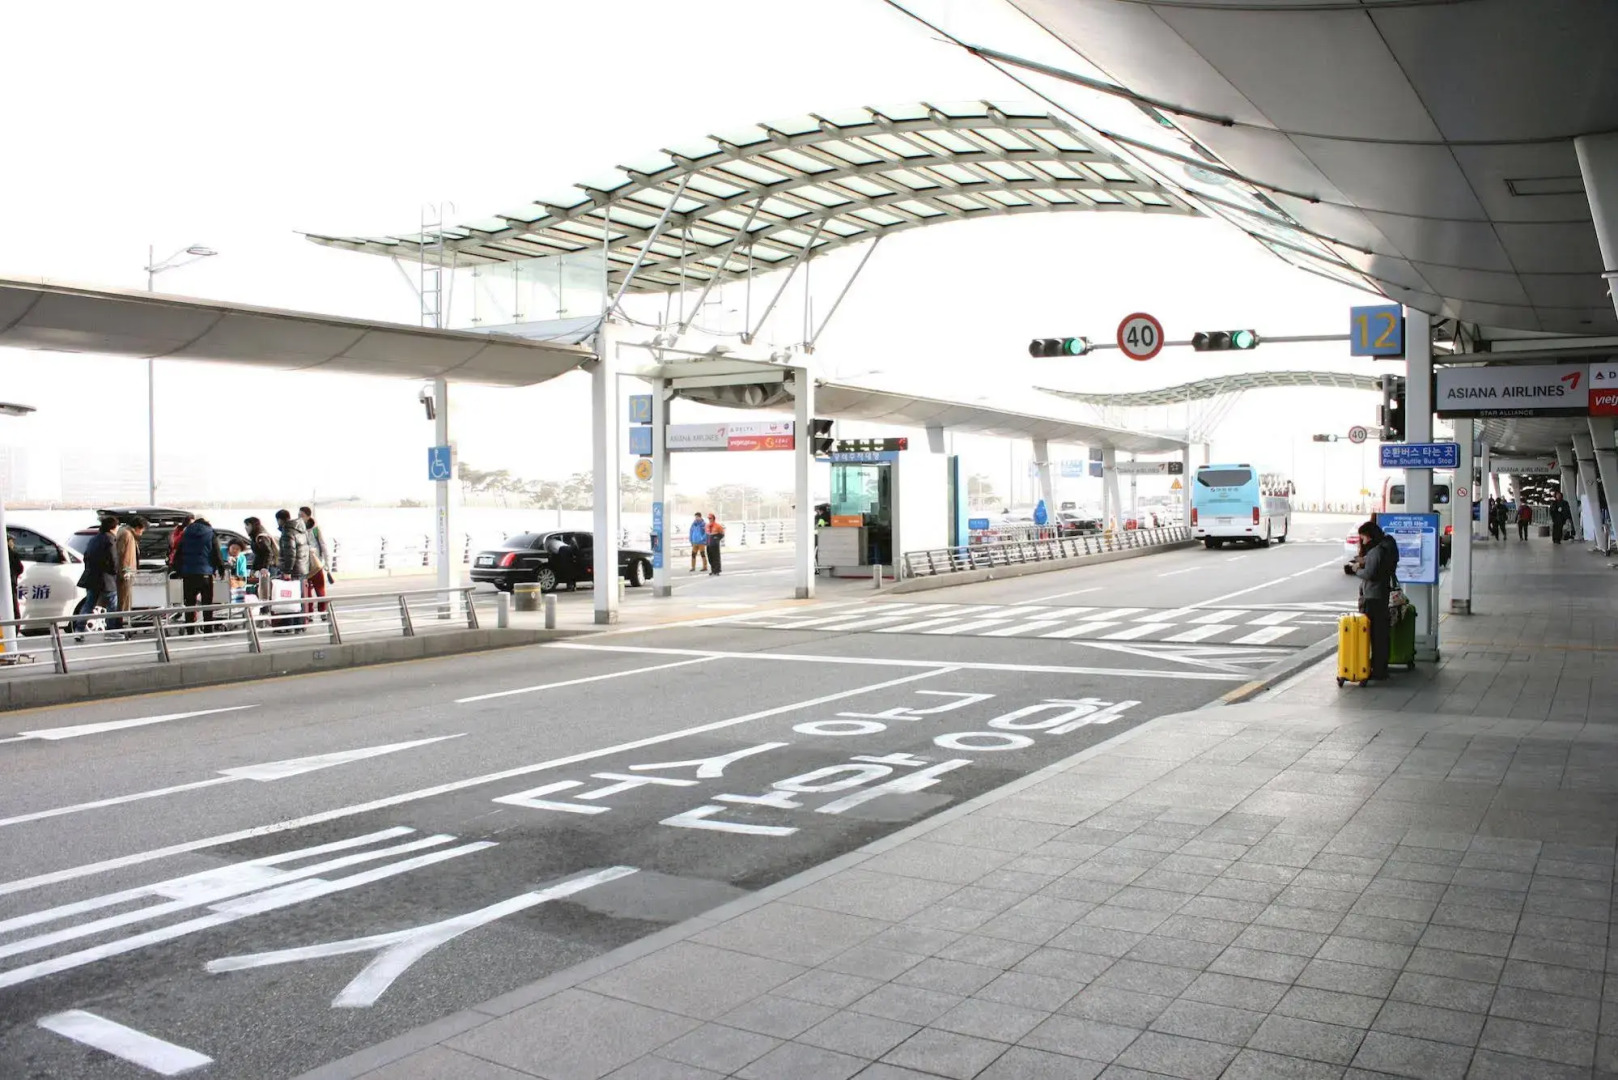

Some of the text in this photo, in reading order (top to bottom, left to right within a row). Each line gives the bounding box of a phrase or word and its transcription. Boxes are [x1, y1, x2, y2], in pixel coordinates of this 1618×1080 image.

[1126, 325, 1154, 347] 40
[1354, 312, 1397, 348] 12
[1447, 385, 1565, 399] ASIANA AIRLINES
[631, 398, 649, 419] 12
[1499, 408, 1534, 416] ALLIANCE
[1352, 430, 1364, 439] 40
[1382, 446, 1454, 457] 순환버스 타는 곳
[1399, 457, 1422, 465] Shuttle
[1423, 457, 1436, 465] Bus
[1437, 457, 1453, 465] Stop
